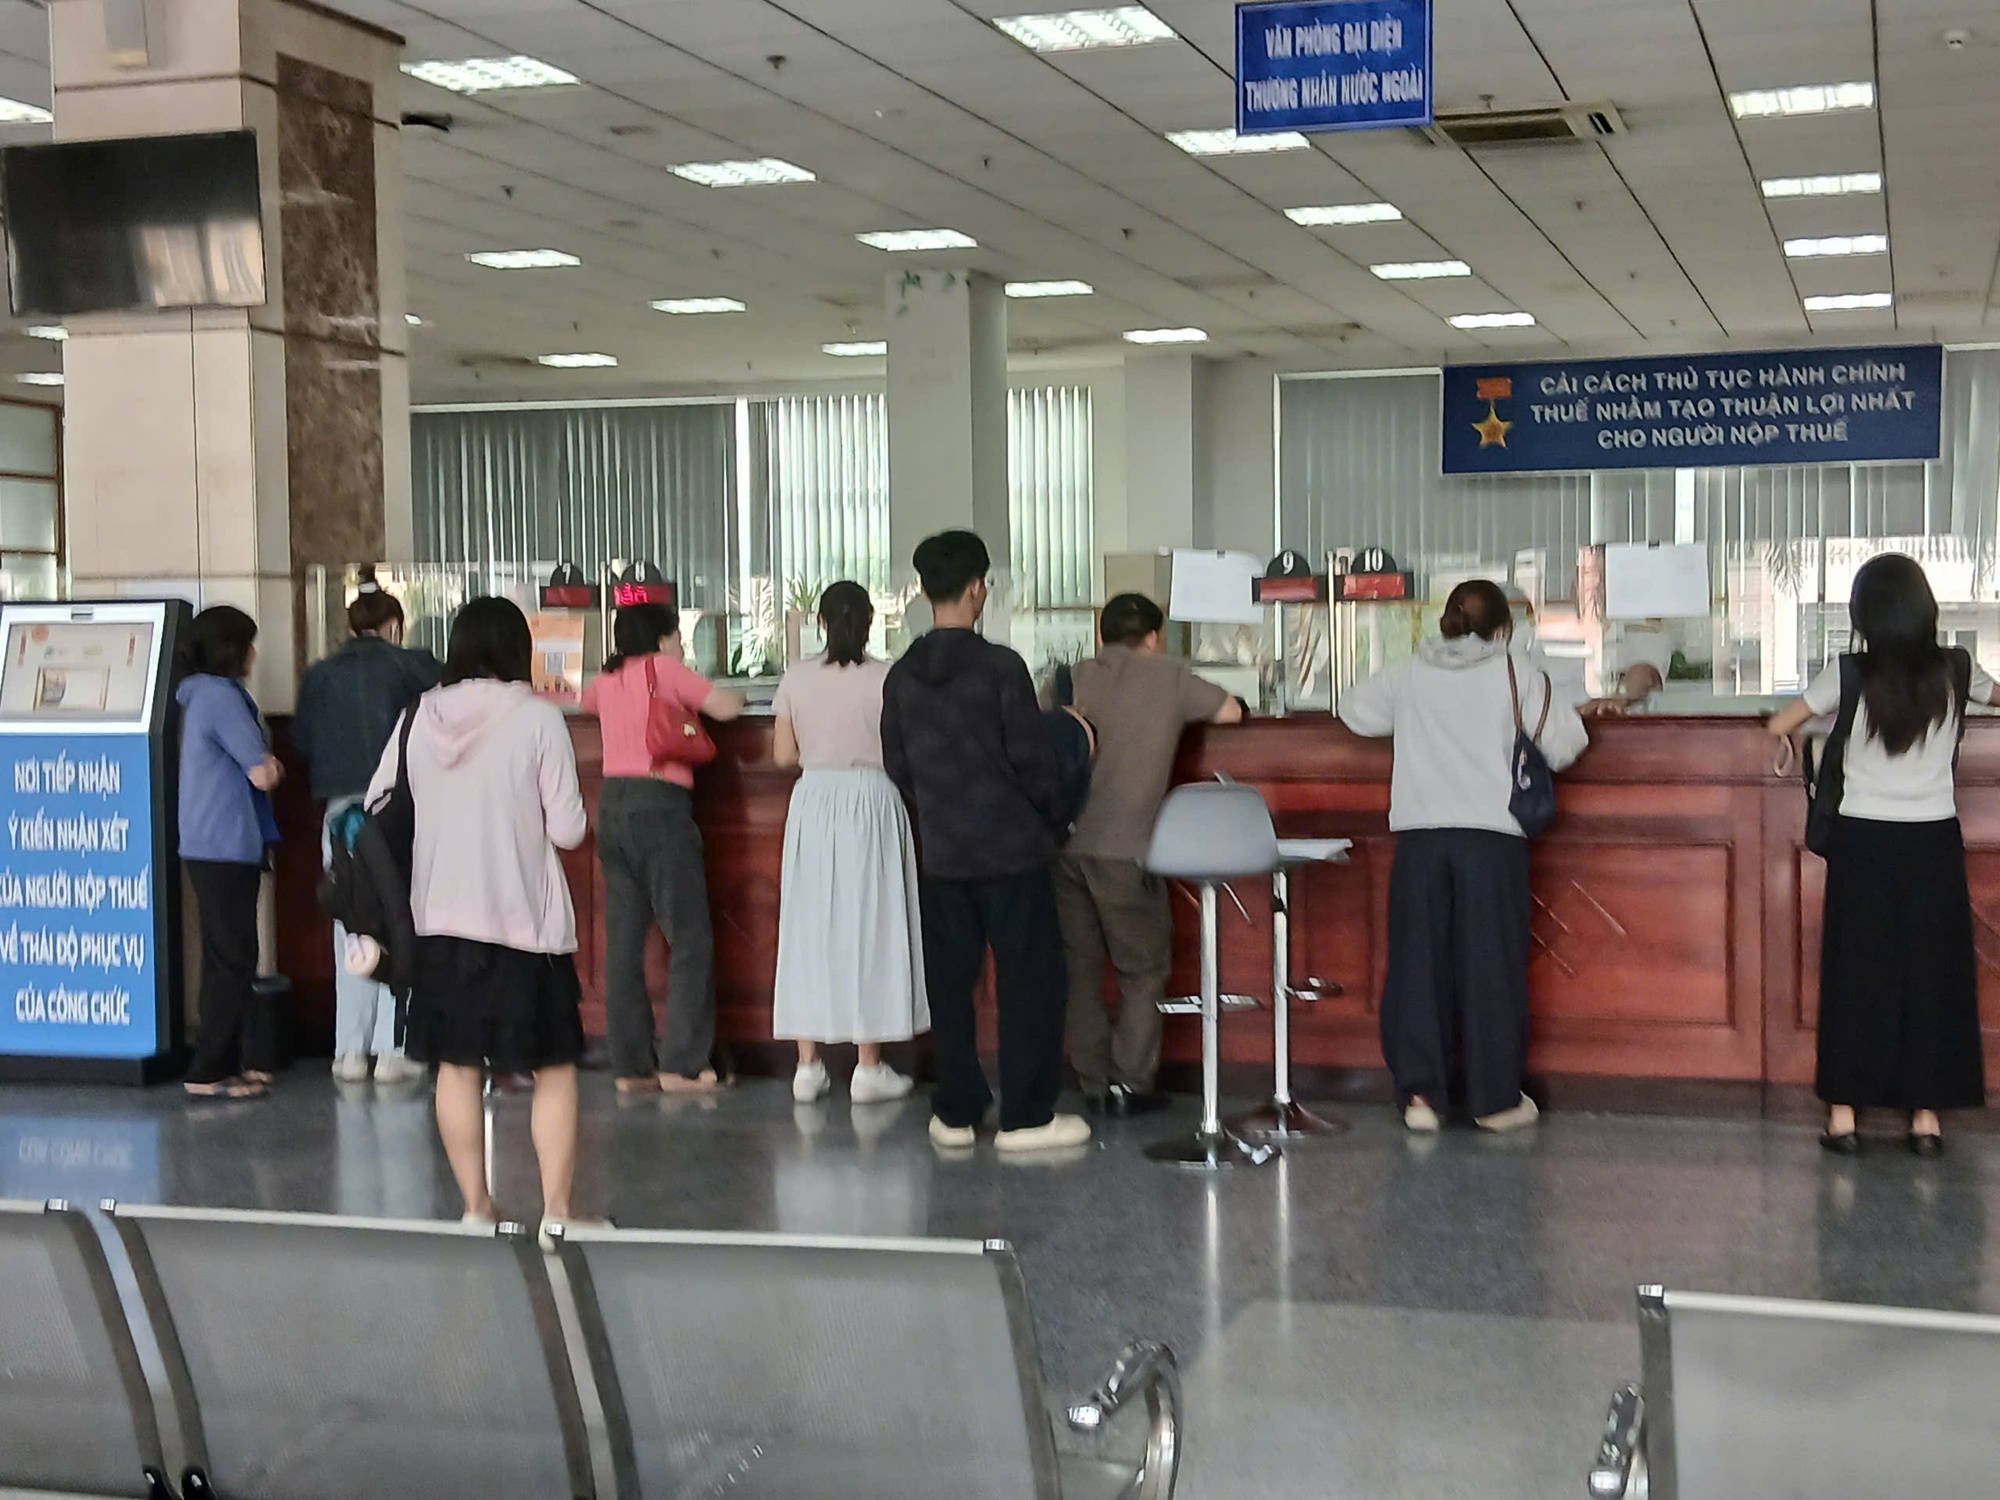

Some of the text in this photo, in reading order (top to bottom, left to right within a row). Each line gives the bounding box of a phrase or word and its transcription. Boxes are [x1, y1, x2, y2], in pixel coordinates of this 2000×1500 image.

[1295, 17, 1341, 57] PHÒNG
[1371, 12, 1402, 57] DIỆN
[1341, 65, 1379, 105] NƯỚC
[1382, 63, 1423, 104] NGOÀI
[1540, 360, 1906, 396] CẢI CÁCH THỦ TỤC HÀNH CHÍNH
[1530, 396, 1590, 424] THUẾ
[1667, 398, 1715, 421] TẠO
[1719, 391, 1799, 419] THUẬN
[1806, 392, 1845, 416] LỢI
[1851, 385, 1916, 412] NHẤT
[1598, 415, 1849, 449] CHO NGƯỜI NỘP THUẾ
[1282, 551, 1293, 574] 9
[1364, 549, 1383, 572] 10
[14, 748, 121, 802] NƠI TIẾP NHẬN
[8, 805, 129, 859] Ý KIẾN NHẬN XÉT
[0, 863, 149, 916] ỦA NGƯỜI NỘP THUẾ
[21, 924, 53, 966] THÁI
[56, 924, 78, 973] ĐỘ
[81, 931, 121, 974] PHỤC
[122, 932, 144, 975] VỤ
[16, 981, 130, 1026] CỦA CÔNG CHỨC
